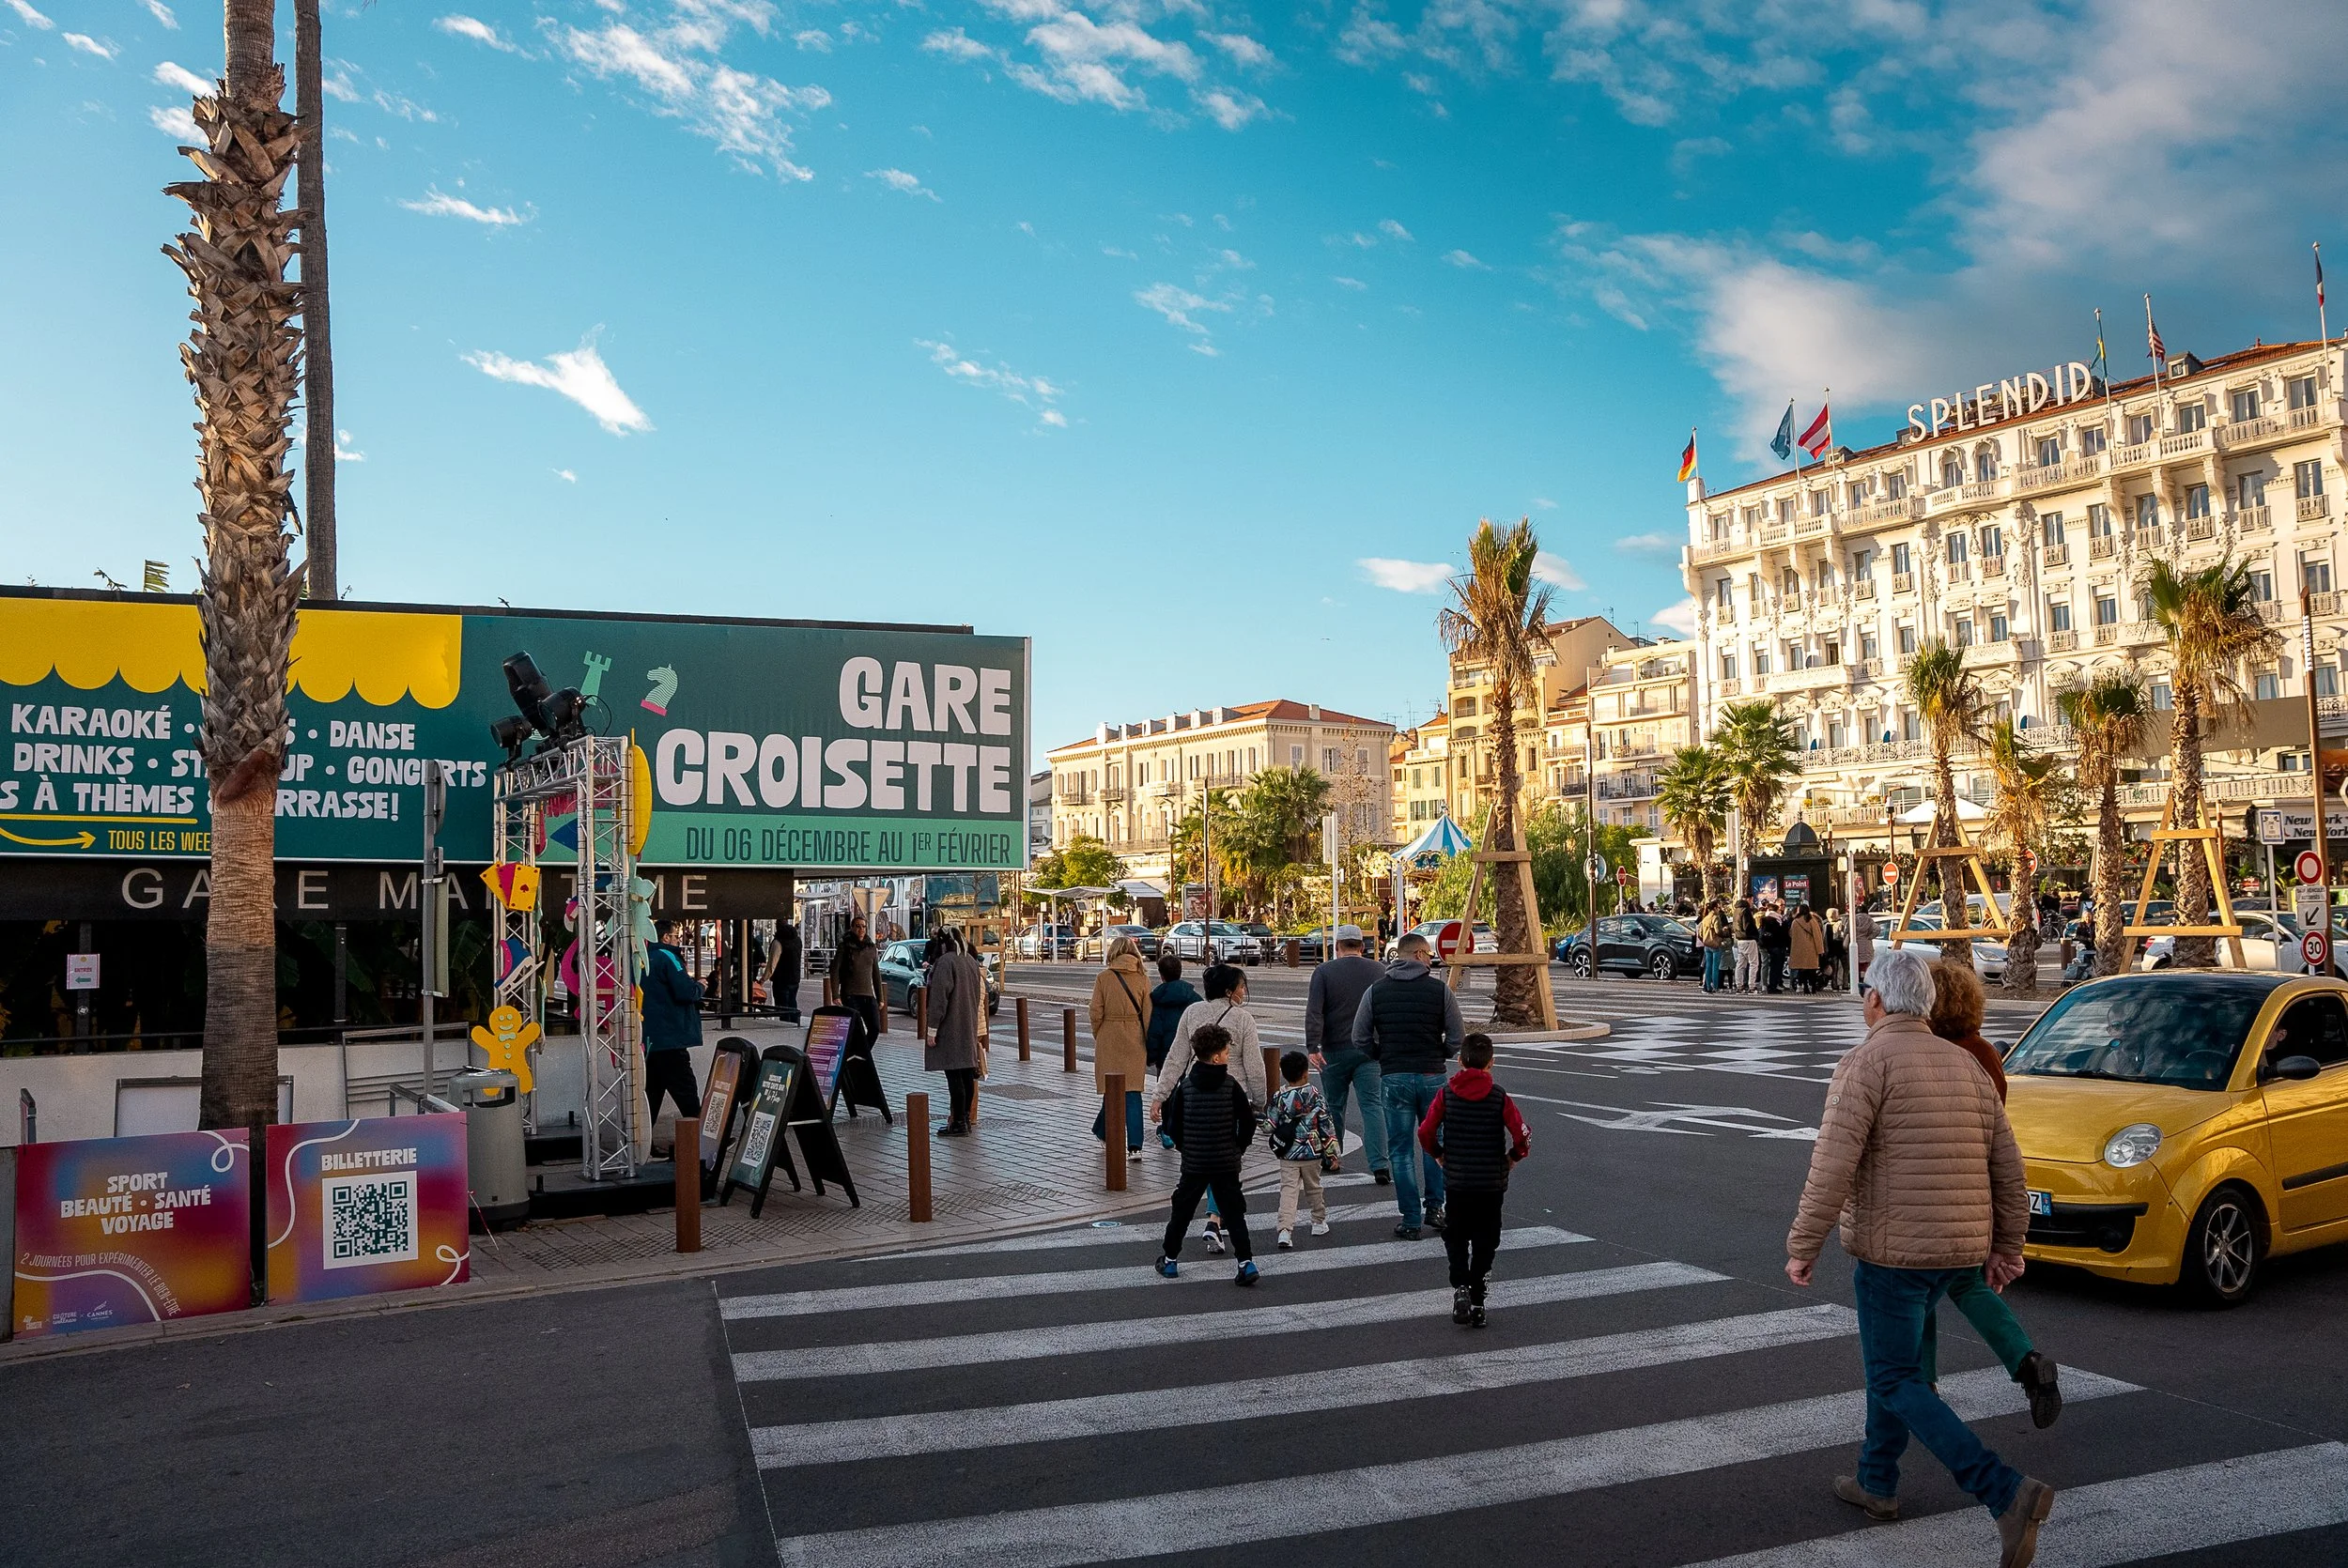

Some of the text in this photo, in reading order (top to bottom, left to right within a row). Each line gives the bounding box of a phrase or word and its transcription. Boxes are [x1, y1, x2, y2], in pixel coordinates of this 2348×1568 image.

[1908, 361, 2092, 443] SPLENDID
[839, 655, 1012, 736] GARE
[11, 703, 172, 740] KARAOKÉ
[330, 720, 415, 750] DANSE
[13, 742, 134, 776] DRINKS
[348, 756, 487, 788] CONCRTS
[656, 728, 1012, 814] CROISETTE
[33, 775, 58, 811] À
[73, 776, 194, 815] THÈMES
[274, 789, 399, 822] RRASSE!
[2284, 814, 2342, 825] New ork
[108, 829, 145, 851] TOUS
[150, 831, 176, 851] LES
[687, 823, 1011, 865] DU 06 DÉCEMBRE AU 1ER FÉVRIER
[121, 867, 330, 910] GAE
[2308, 941, 2322, 955] 30
[321, 1147, 417, 1172] BILLETTERIE
[60, 1184, 211, 1219] BEAUTÉ SANTÉ
[107, 1171, 168, 1193] SPORT
[100, 1211, 174, 1235] VOYAGE
[21, 1250, 181, 1316] 2 JOURNÉES POUR EXPÉRIMENTER LE BIEN-ÊTRE
[86, 1309, 114, 1318] CANNES
